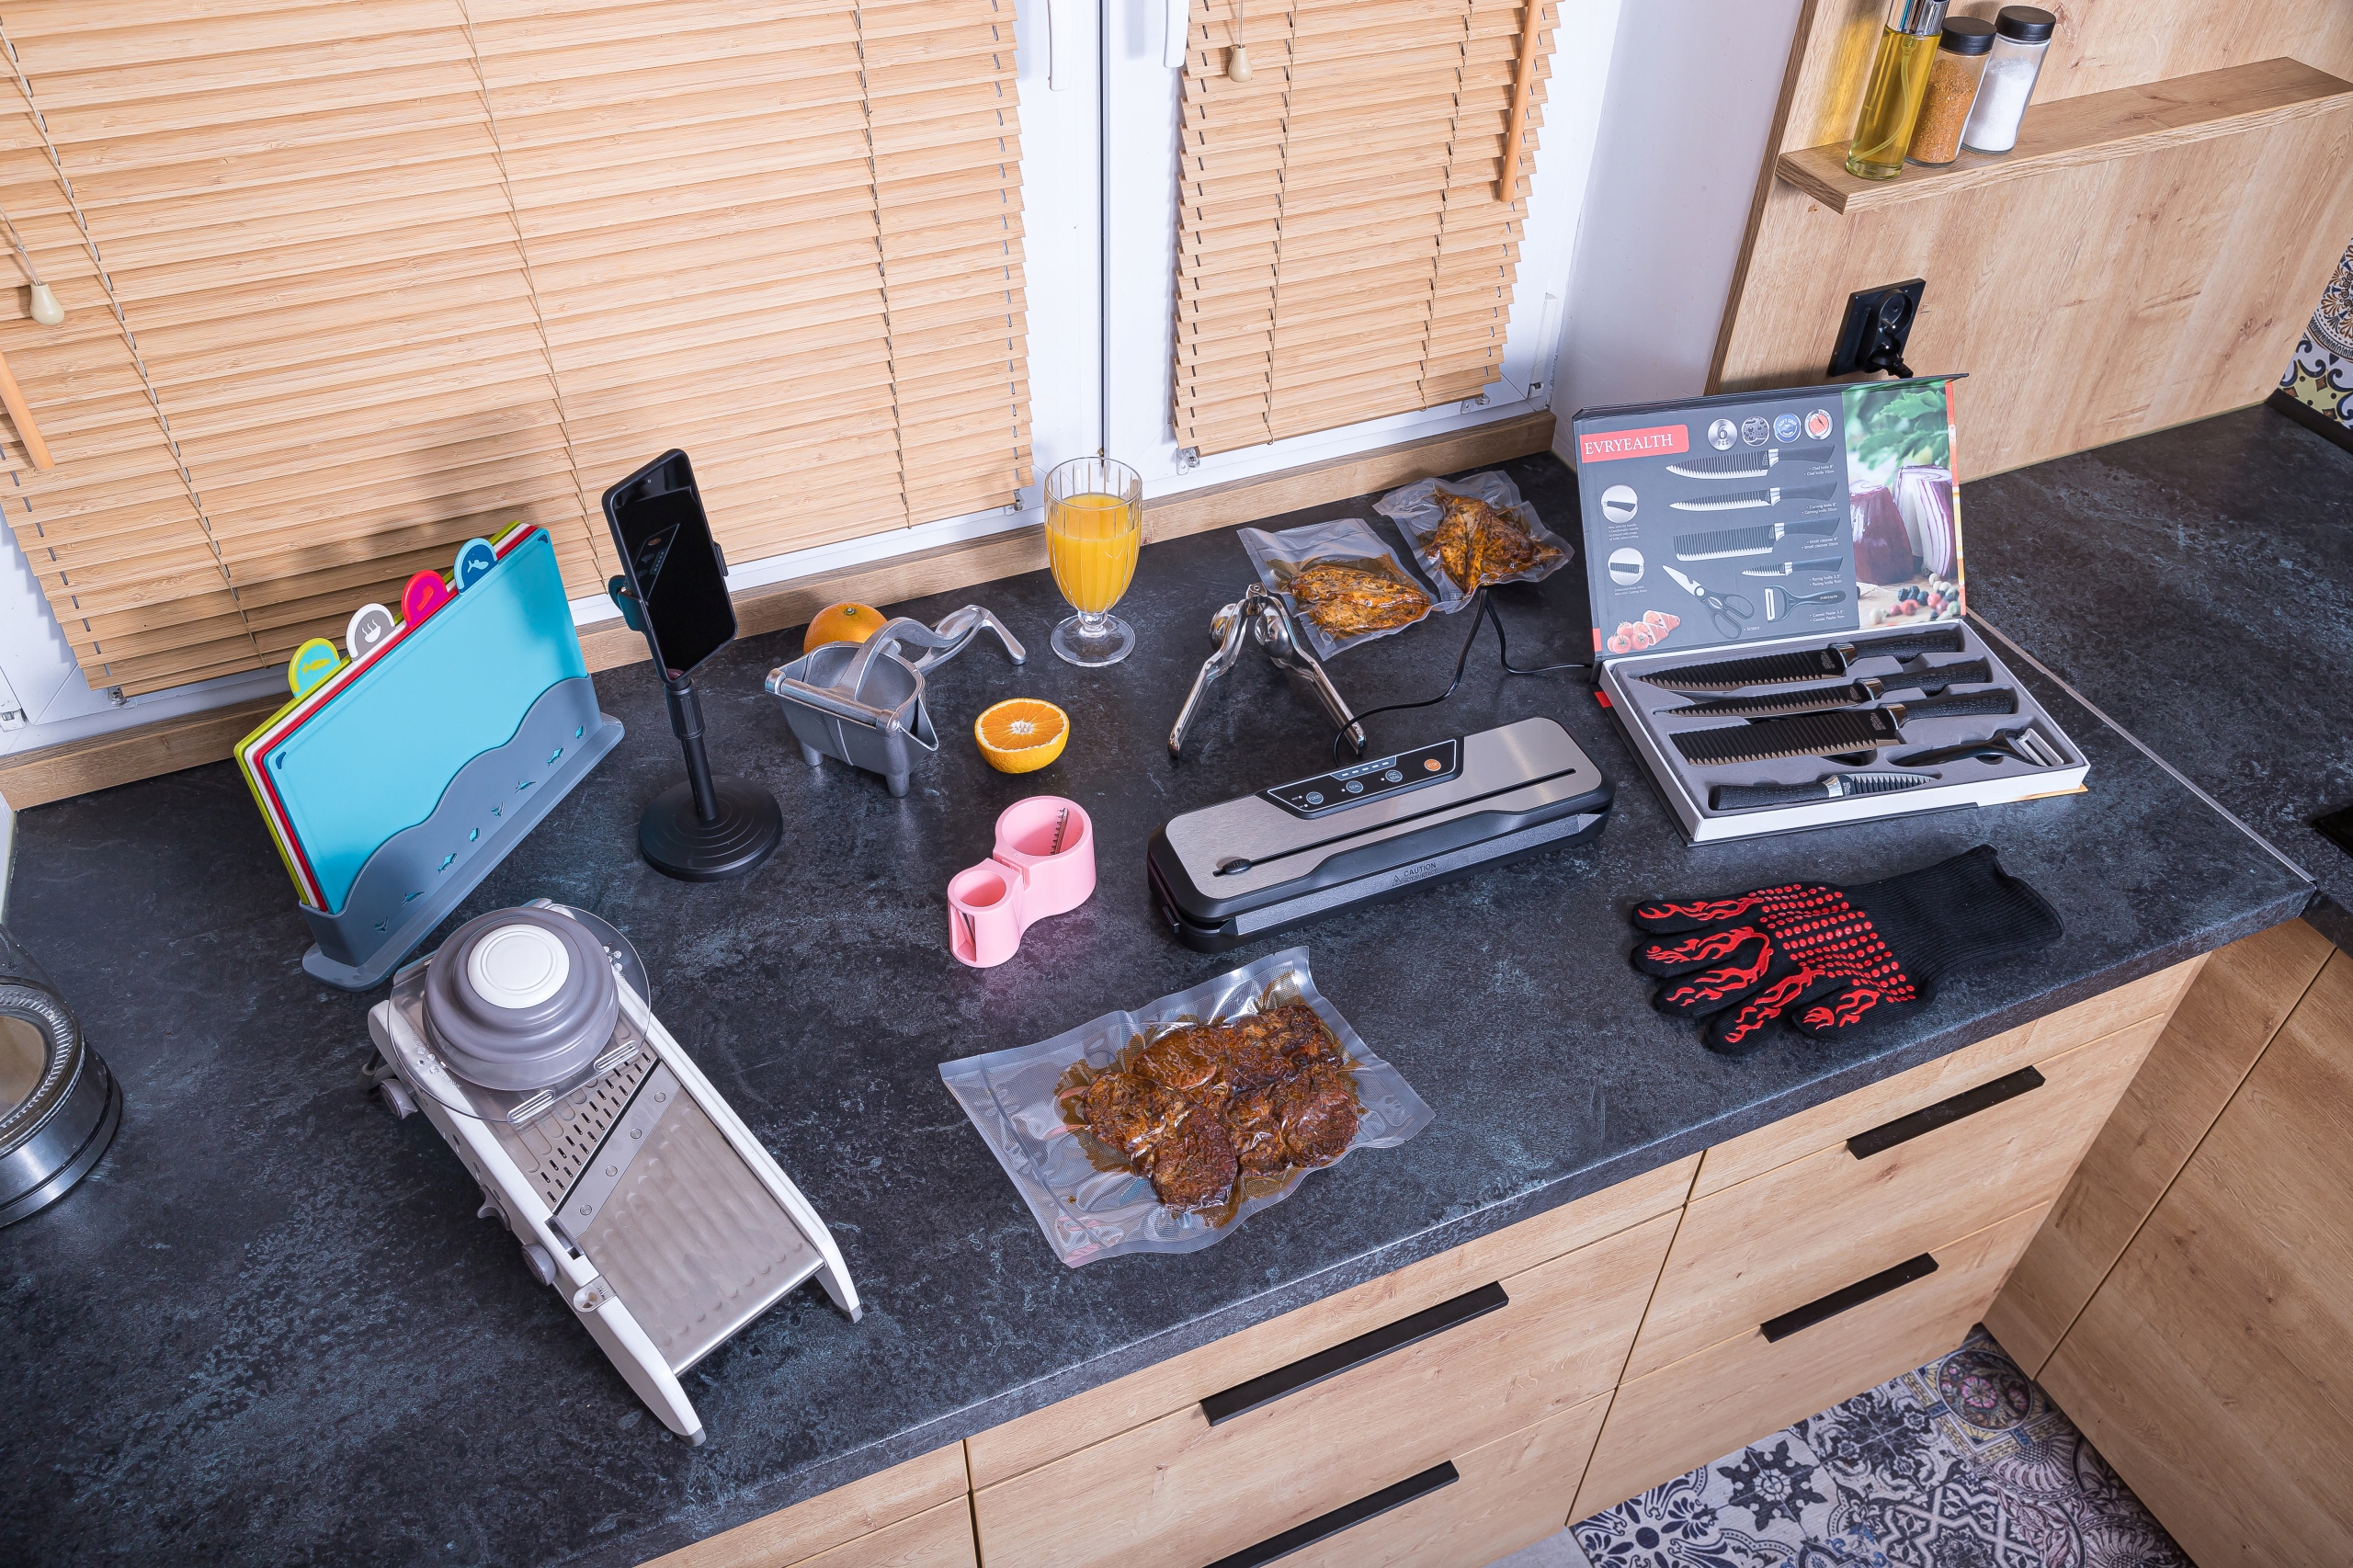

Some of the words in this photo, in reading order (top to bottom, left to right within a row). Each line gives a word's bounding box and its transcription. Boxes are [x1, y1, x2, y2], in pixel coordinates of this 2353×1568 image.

[1717, 424, 1728, 439] 6
[1584, 433, 1674, 455] EVRYEALTH
[1404, 862, 1437, 877] CAUTION
